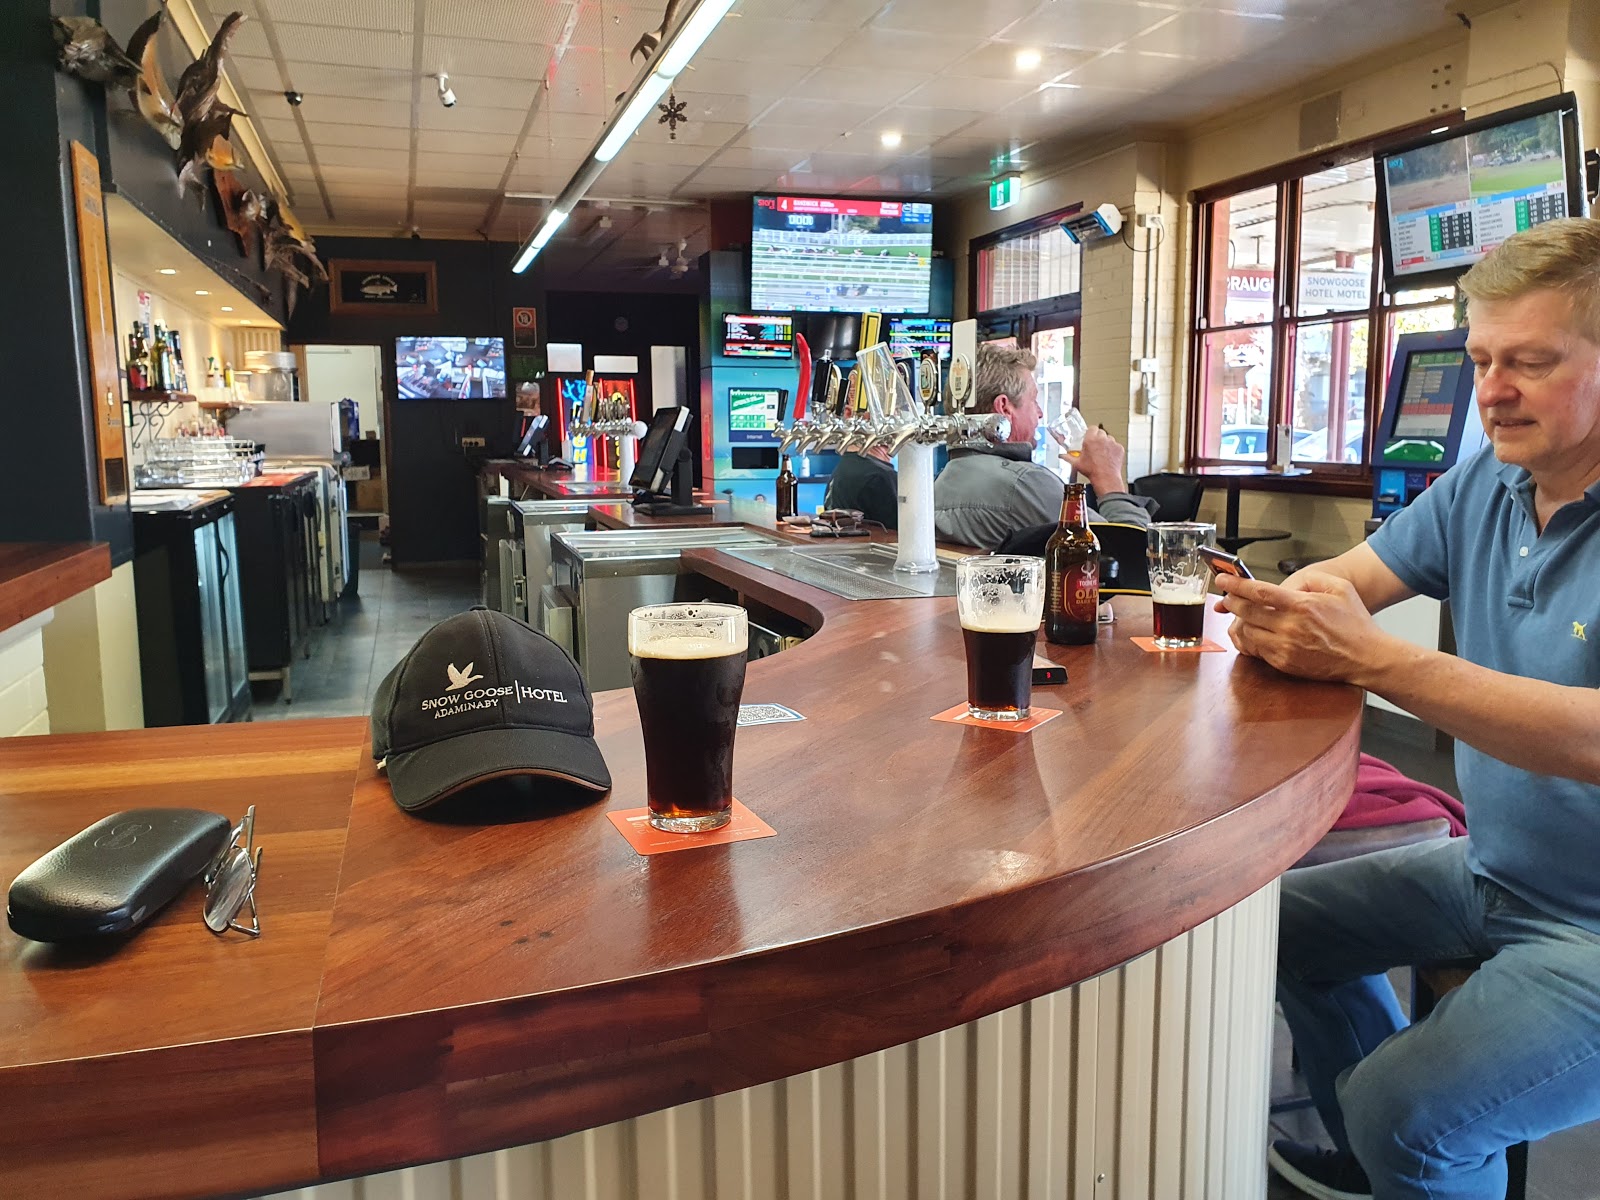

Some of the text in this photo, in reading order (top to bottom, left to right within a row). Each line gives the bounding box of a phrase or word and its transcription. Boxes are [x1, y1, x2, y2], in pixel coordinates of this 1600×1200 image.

[1308, 276, 1365, 287] SNOWGOOSE
[1305, 288, 1367, 300] HOTEL MOTEL
[1075, 588, 1099, 600] OLD
[421, 686, 567, 711] SNOW GOOSE HOTEL
[435, 699, 499, 720] ADAMINABY
